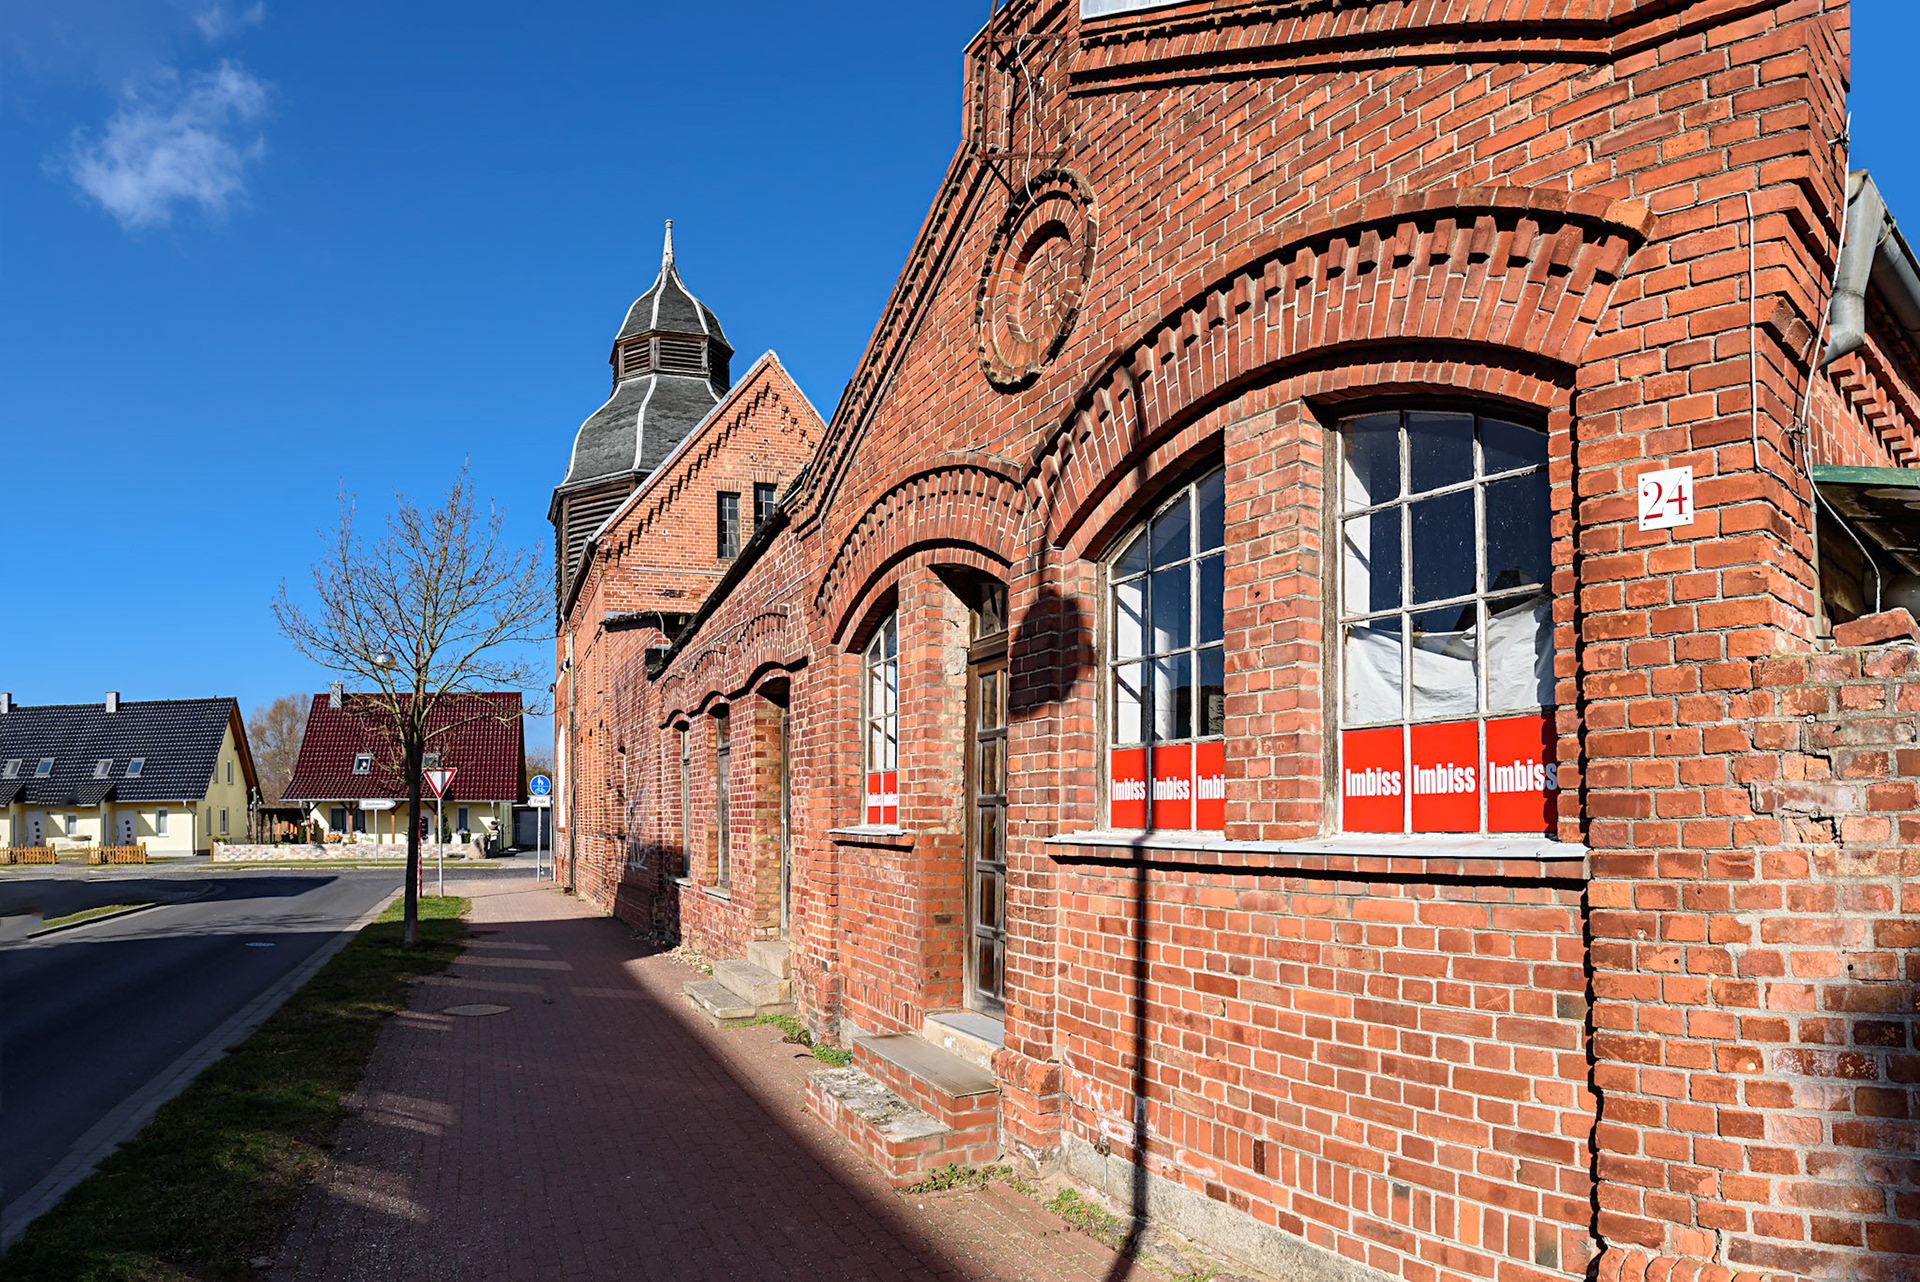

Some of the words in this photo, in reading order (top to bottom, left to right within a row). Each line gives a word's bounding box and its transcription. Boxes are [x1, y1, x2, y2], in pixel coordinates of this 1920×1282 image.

[1643, 476, 1687, 520] 24
[1111, 778, 1146, 801] Imbiss
[1152, 776, 1190, 801] Imbiss
[1198, 774, 1225, 799] Imbi
[1345, 767, 1402, 797] Imbiss
[1413, 762, 1476, 794] Imbiss
[1488, 758, 1557, 793] Imbiss
